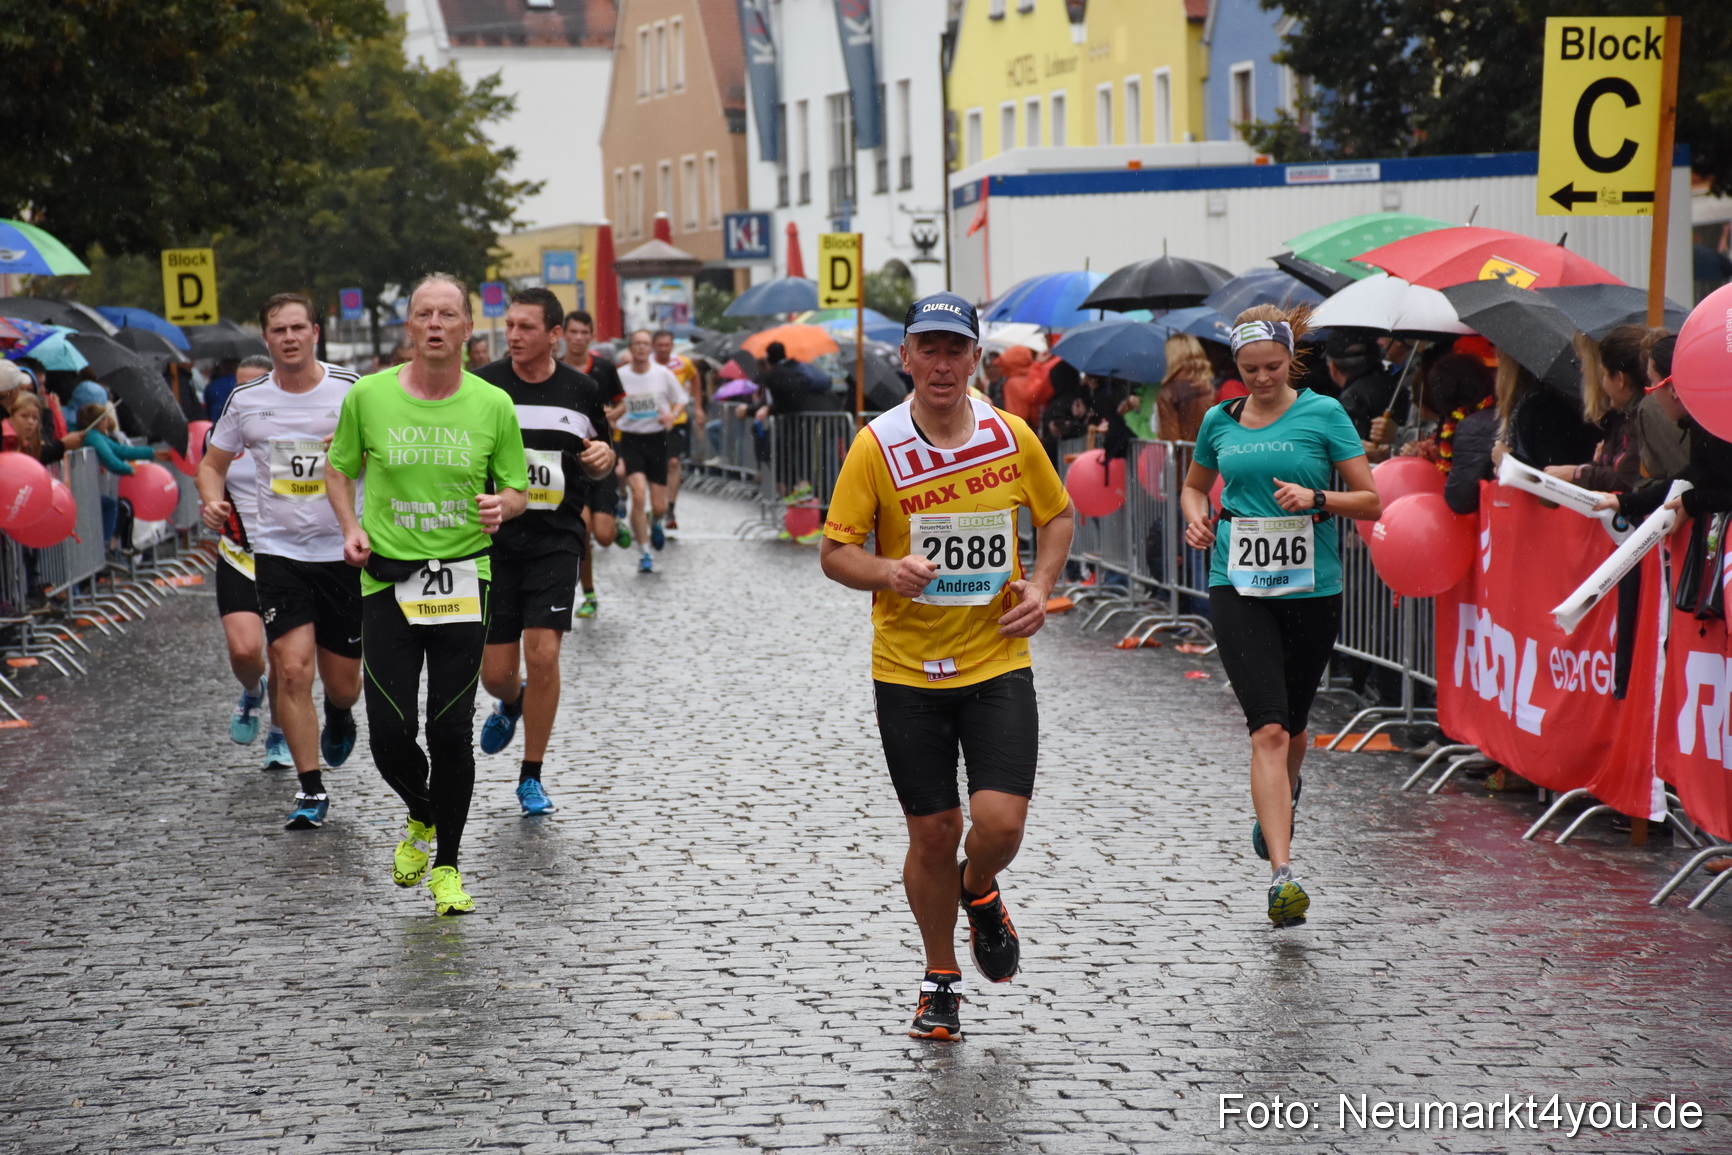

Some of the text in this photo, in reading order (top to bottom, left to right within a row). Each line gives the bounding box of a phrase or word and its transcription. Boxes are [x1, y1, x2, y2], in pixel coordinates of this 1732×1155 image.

[1561, 26, 1663, 60] Block
[1573, 76, 1641, 174] C
[823, 235, 859, 249] Block
[168, 253, 208, 267] Block
[831, 256, 852, 291] D
[177, 273, 204, 308] D
[386, 426, 472, 446] NOVINA
[291, 455, 319, 478] 67
[388, 448, 471, 468] HOTELS
[291, 482, 319, 493] Stefan
[899, 463, 1021, 515] MAX BÖGL
[958, 513, 1006, 527] BOCK
[1263, 520, 1306, 530] BOCK
[922, 534, 1006, 570] 2688
[1238, 536, 1307, 567] 2046
[420, 567, 453, 596] 20
[936, 579, 991, 593] Andreas
[1251, 575, 1289, 586] Andrea
[417, 604, 460, 615] Thomas
